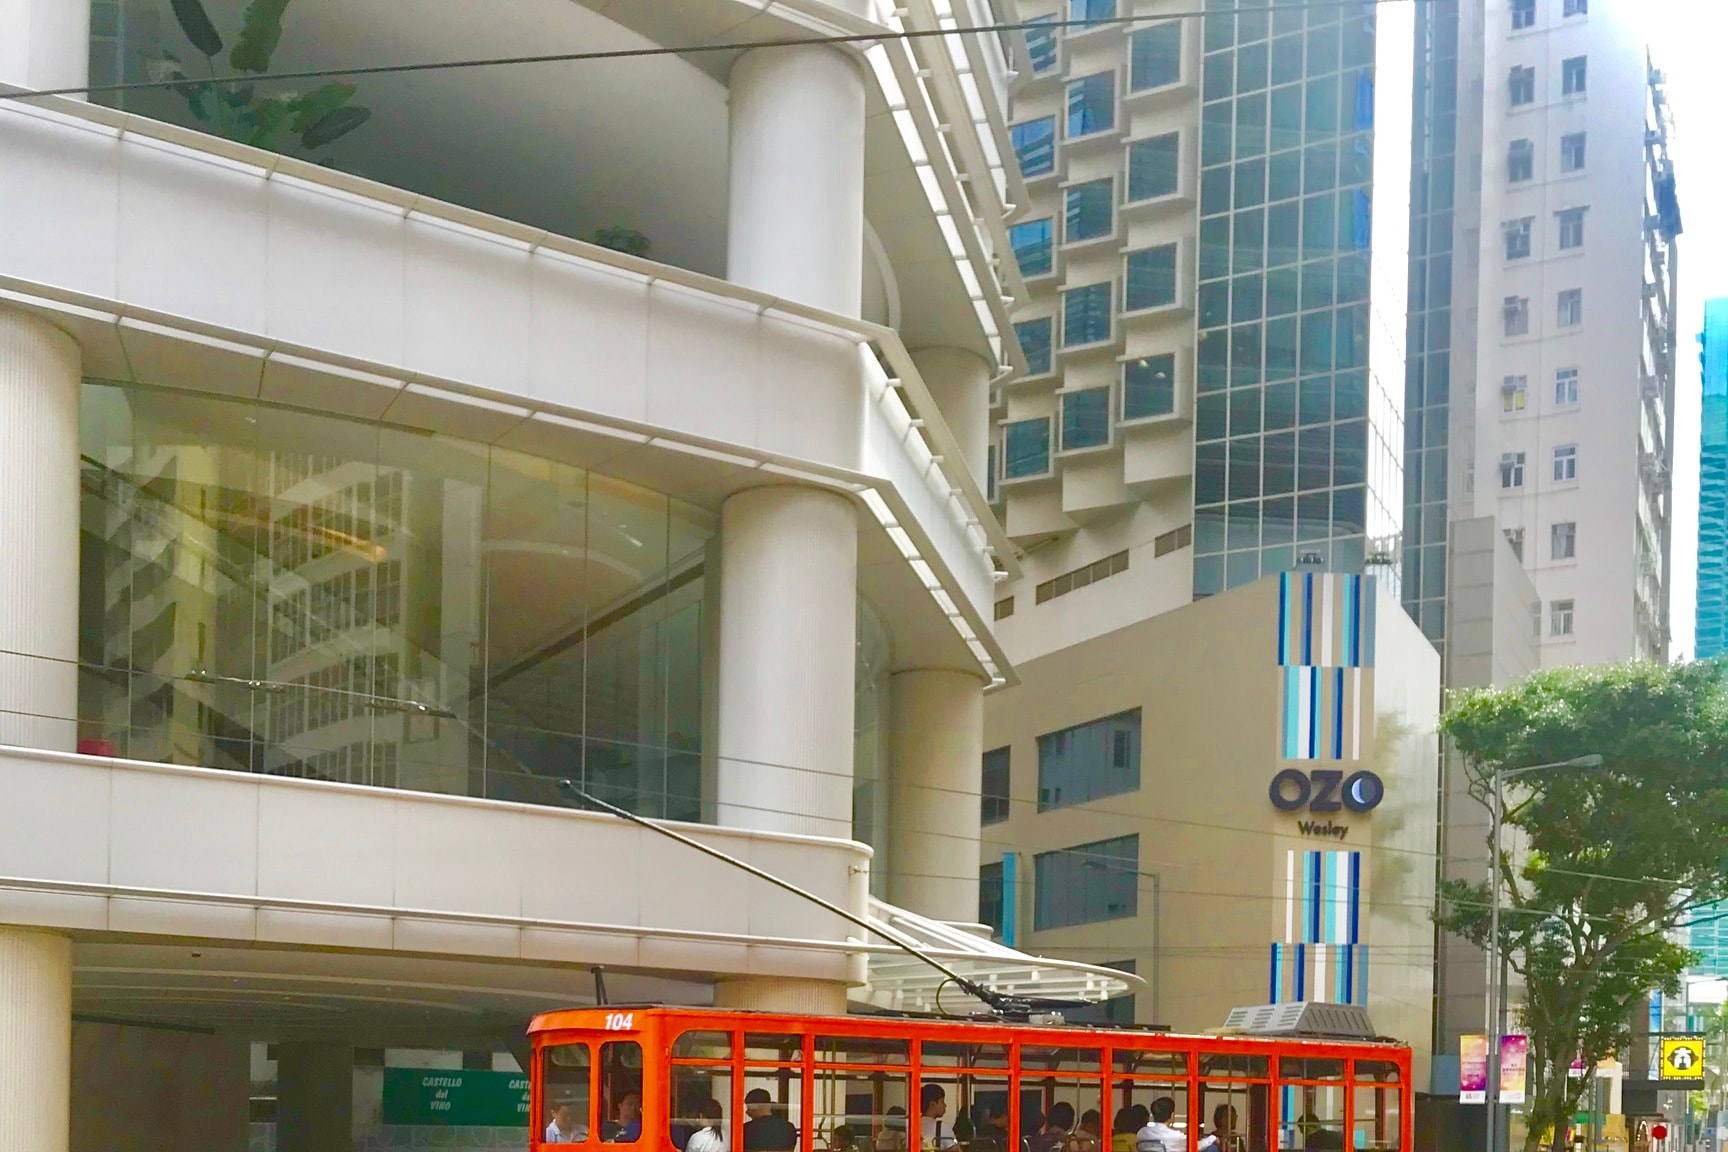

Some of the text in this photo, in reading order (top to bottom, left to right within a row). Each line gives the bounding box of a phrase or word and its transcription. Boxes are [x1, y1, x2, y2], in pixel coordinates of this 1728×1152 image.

[1269, 768, 1384, 813] OZO
[1298, 820, 1349, 840] Wesley
[605, 1012, 633, 1030] 104
[422, 1077, 463, 1087] CASTELLO
[435, 1089, 448, 1099] del
[430, 1101, 451, 1111] VINO
